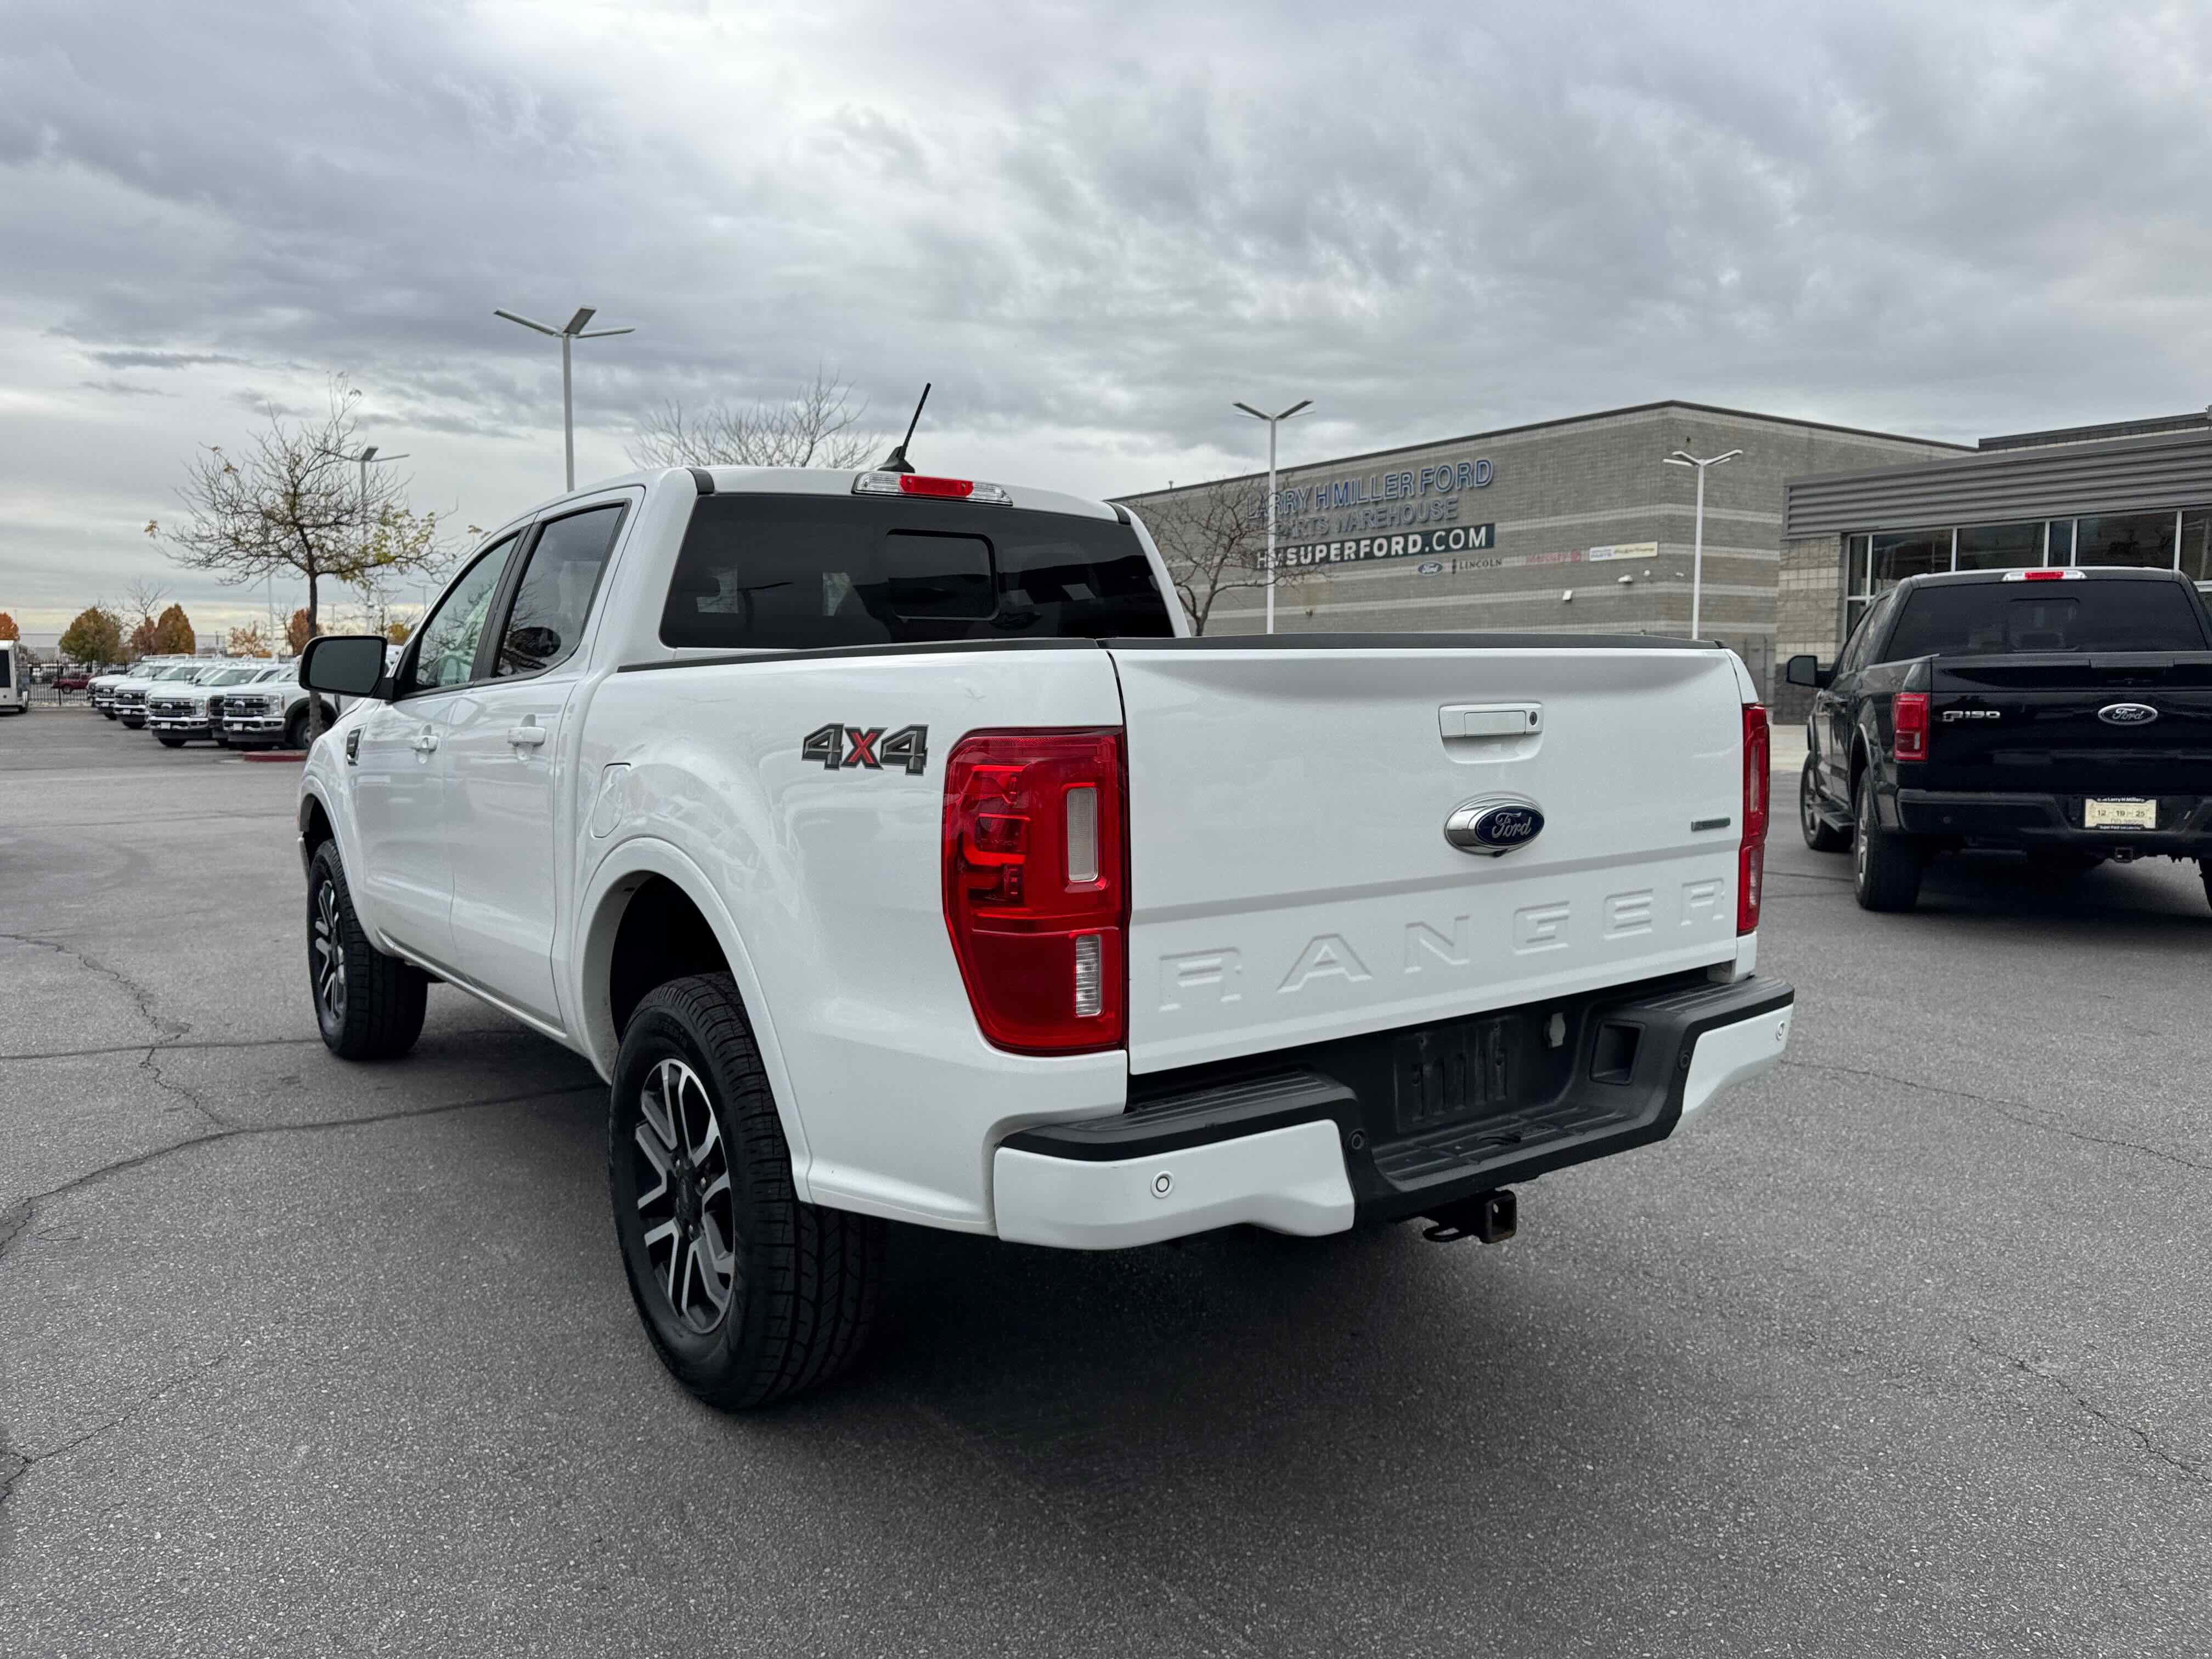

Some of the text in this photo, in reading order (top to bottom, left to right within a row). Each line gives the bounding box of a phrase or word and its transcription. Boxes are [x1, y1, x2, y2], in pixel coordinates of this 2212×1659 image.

[1247, 458, 1493, 519] LARRY H MILLER FORD
[1276, 496, 1458, 539] PARTS WAREHOUSE
[1250, 526, 1486, 569] HSUPERFORD.COM
[1459, 557, 1502, 570] LINCOLN
[1492, 811, 1532, 838] Ford
[1159, 878, 1725, 1011] RANGER
